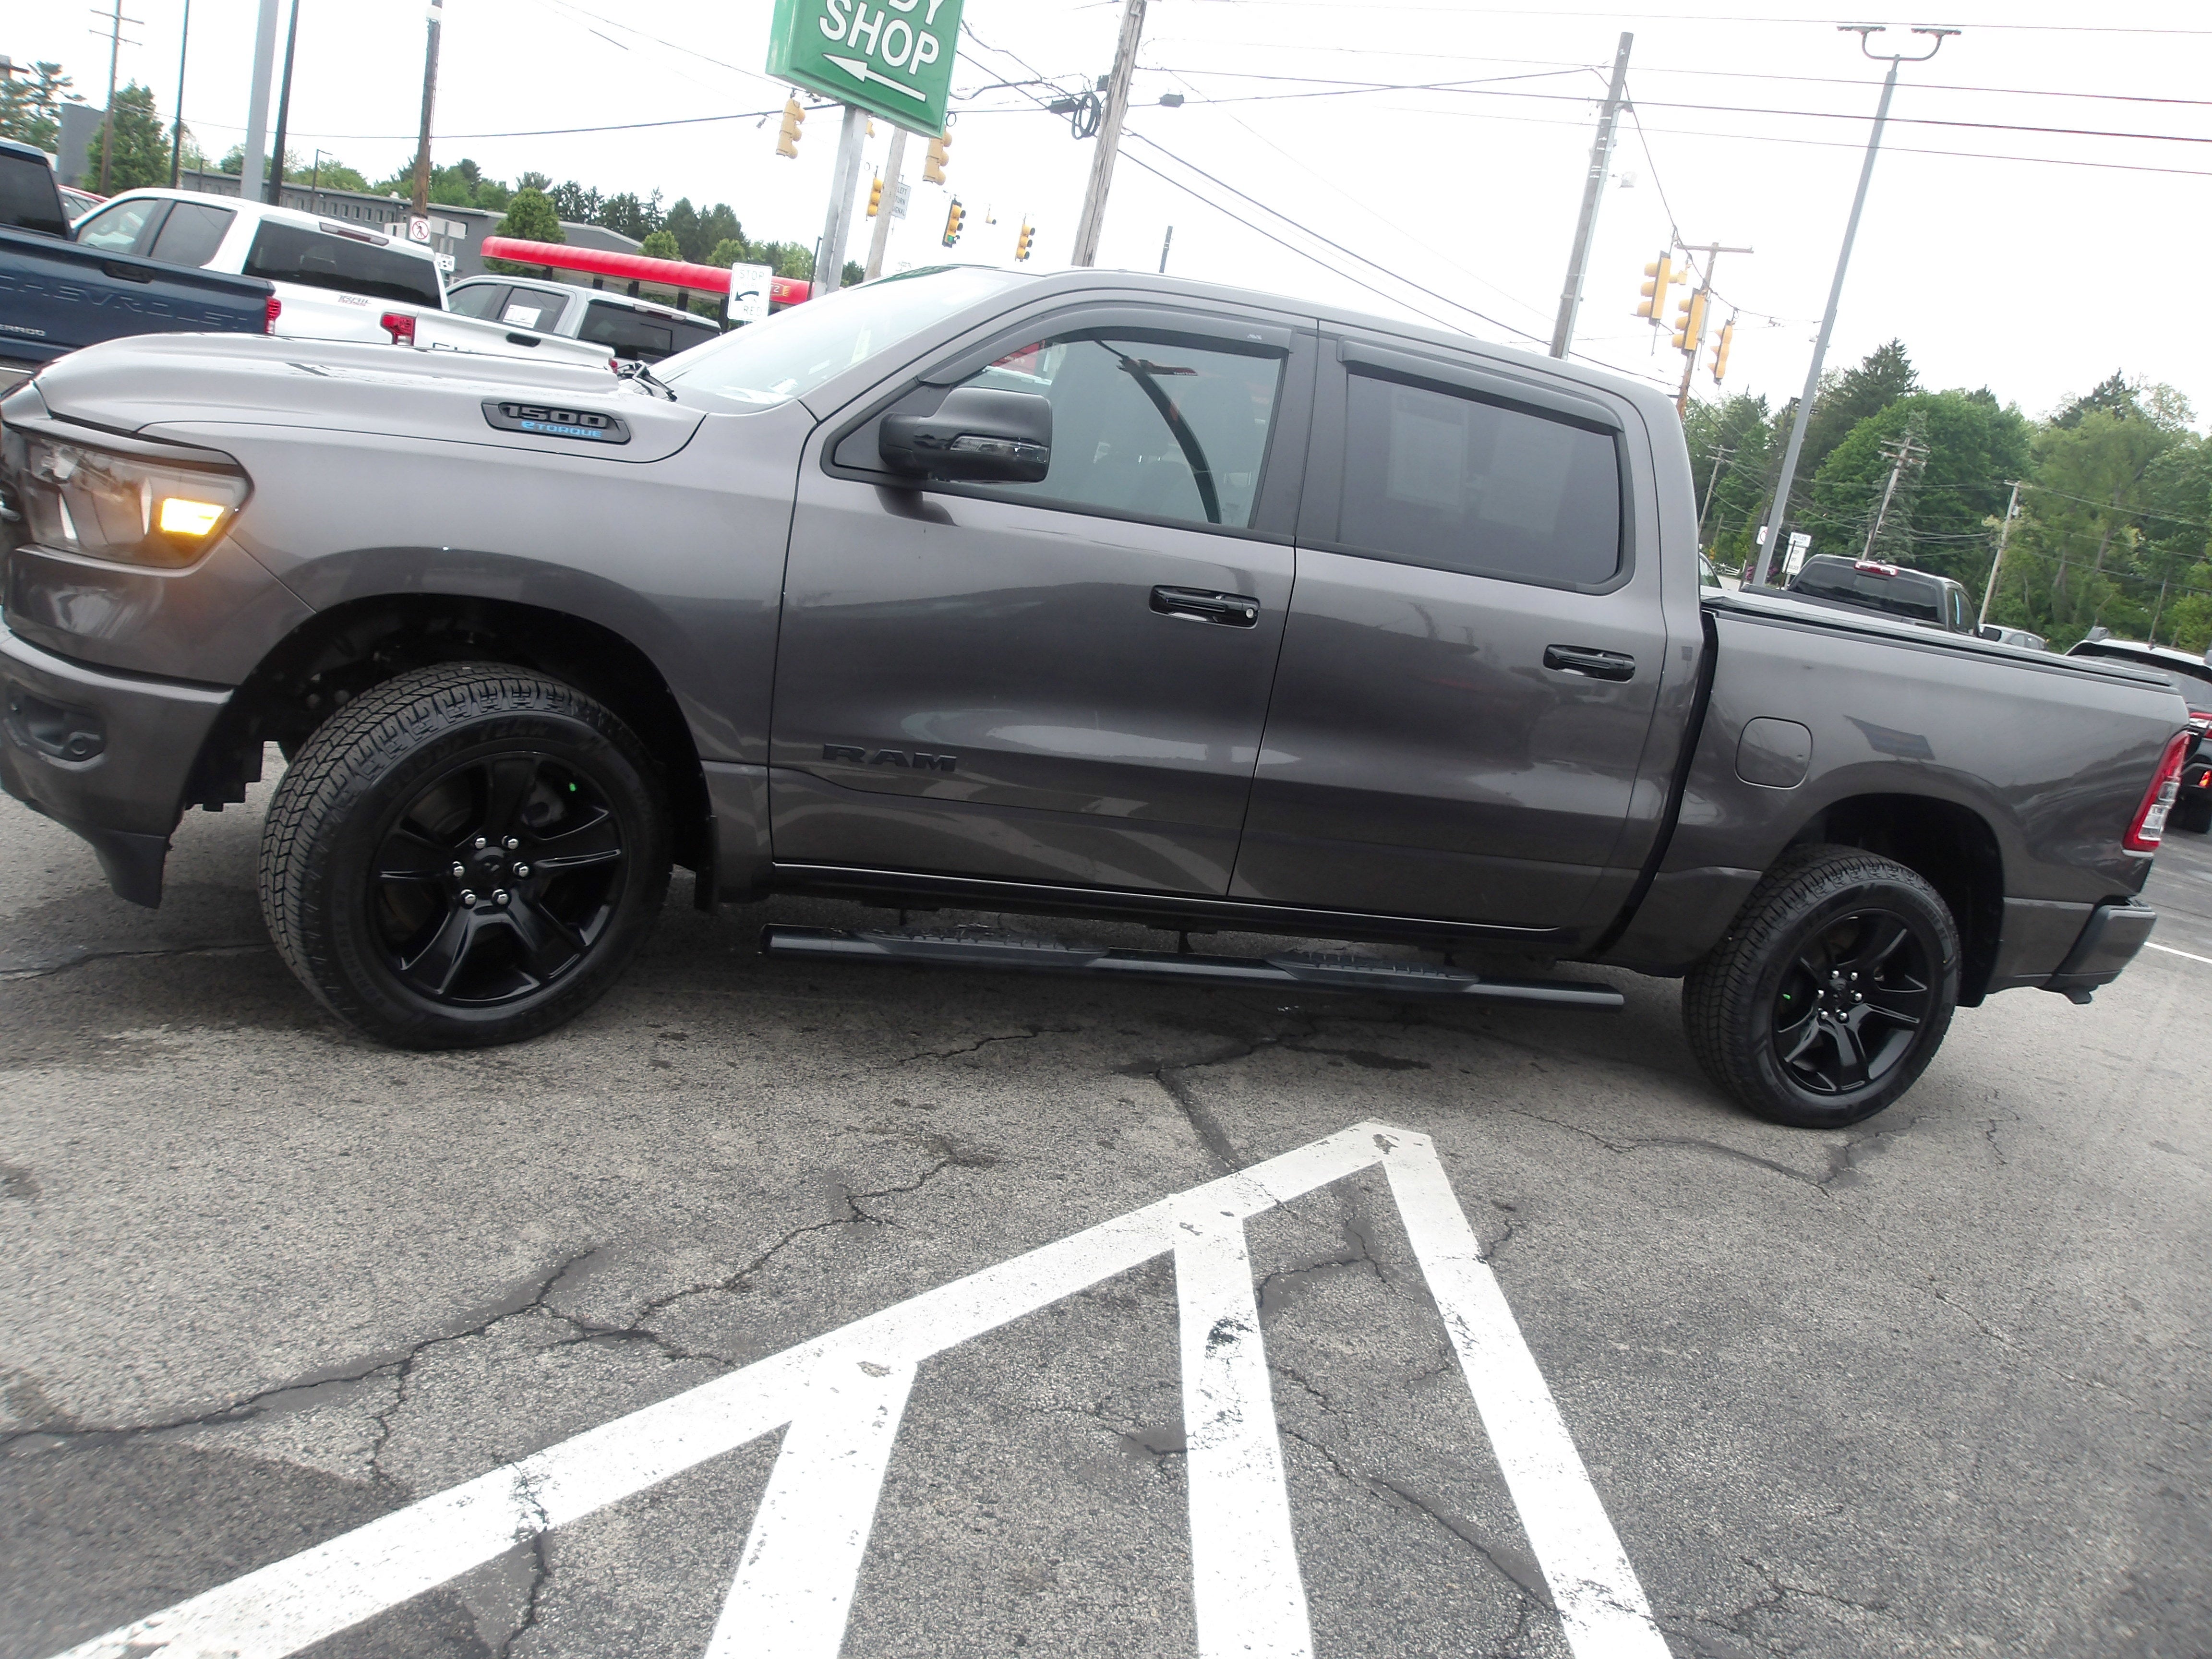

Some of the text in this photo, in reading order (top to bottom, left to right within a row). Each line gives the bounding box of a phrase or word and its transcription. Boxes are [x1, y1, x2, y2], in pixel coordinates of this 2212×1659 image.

[819, 0, 939, 75] SHOP
[897, 187, 907, 195] LEFT
[895, 196, 905, 205] TURN
[892, 206, 905, 216] IGNAL
[740, 269, 764, 280] STOP
[744, 305, 762, 316] RED
[0, 324, 46, 336] ERADO
[506, 404, 608, 429] 1500
[822, 744, 957, 772] RAM
